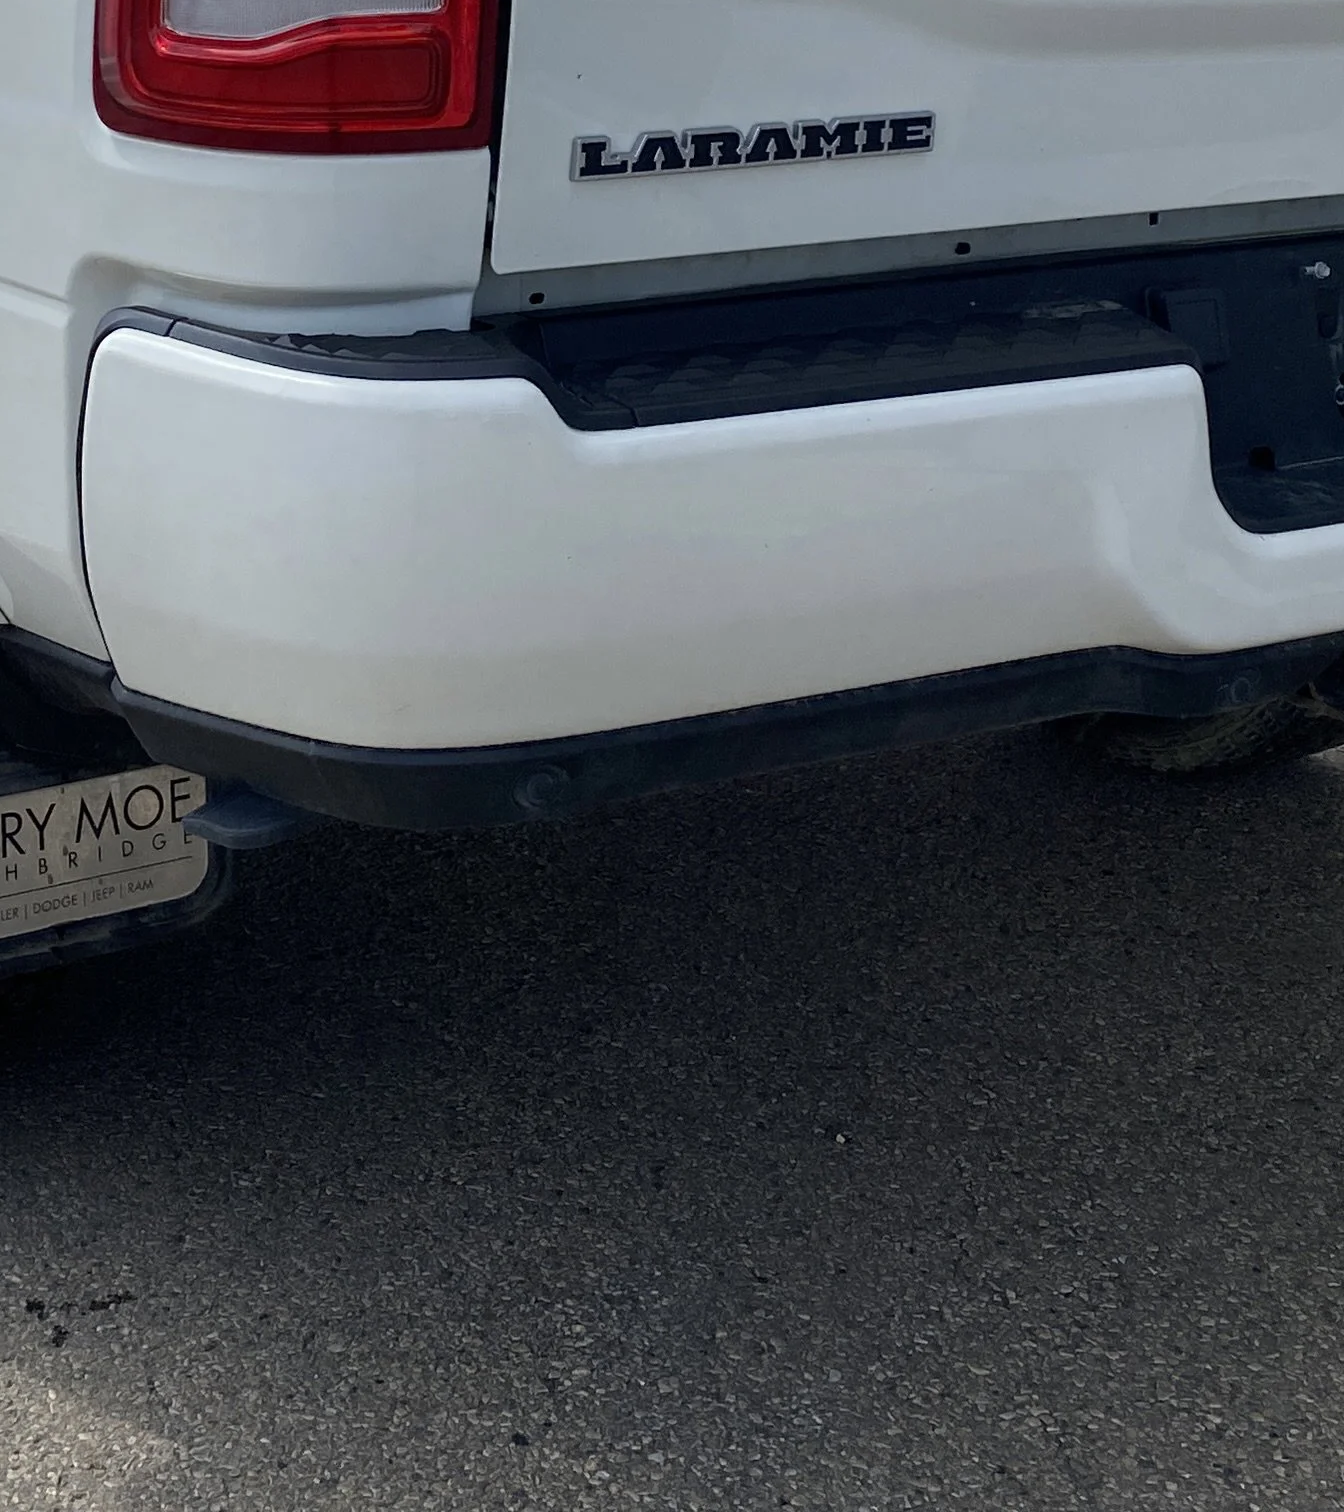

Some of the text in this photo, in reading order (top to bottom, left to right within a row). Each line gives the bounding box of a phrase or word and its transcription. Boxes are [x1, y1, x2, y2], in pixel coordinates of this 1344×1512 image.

[570, 110, 937, 181] LARAMIE
[75, 776, 193, 843] MOE
[33, 894, 78, 915] DODGE
[90, 887, 117, 904] JEEP
[127, 879, 155, 894] RAM
